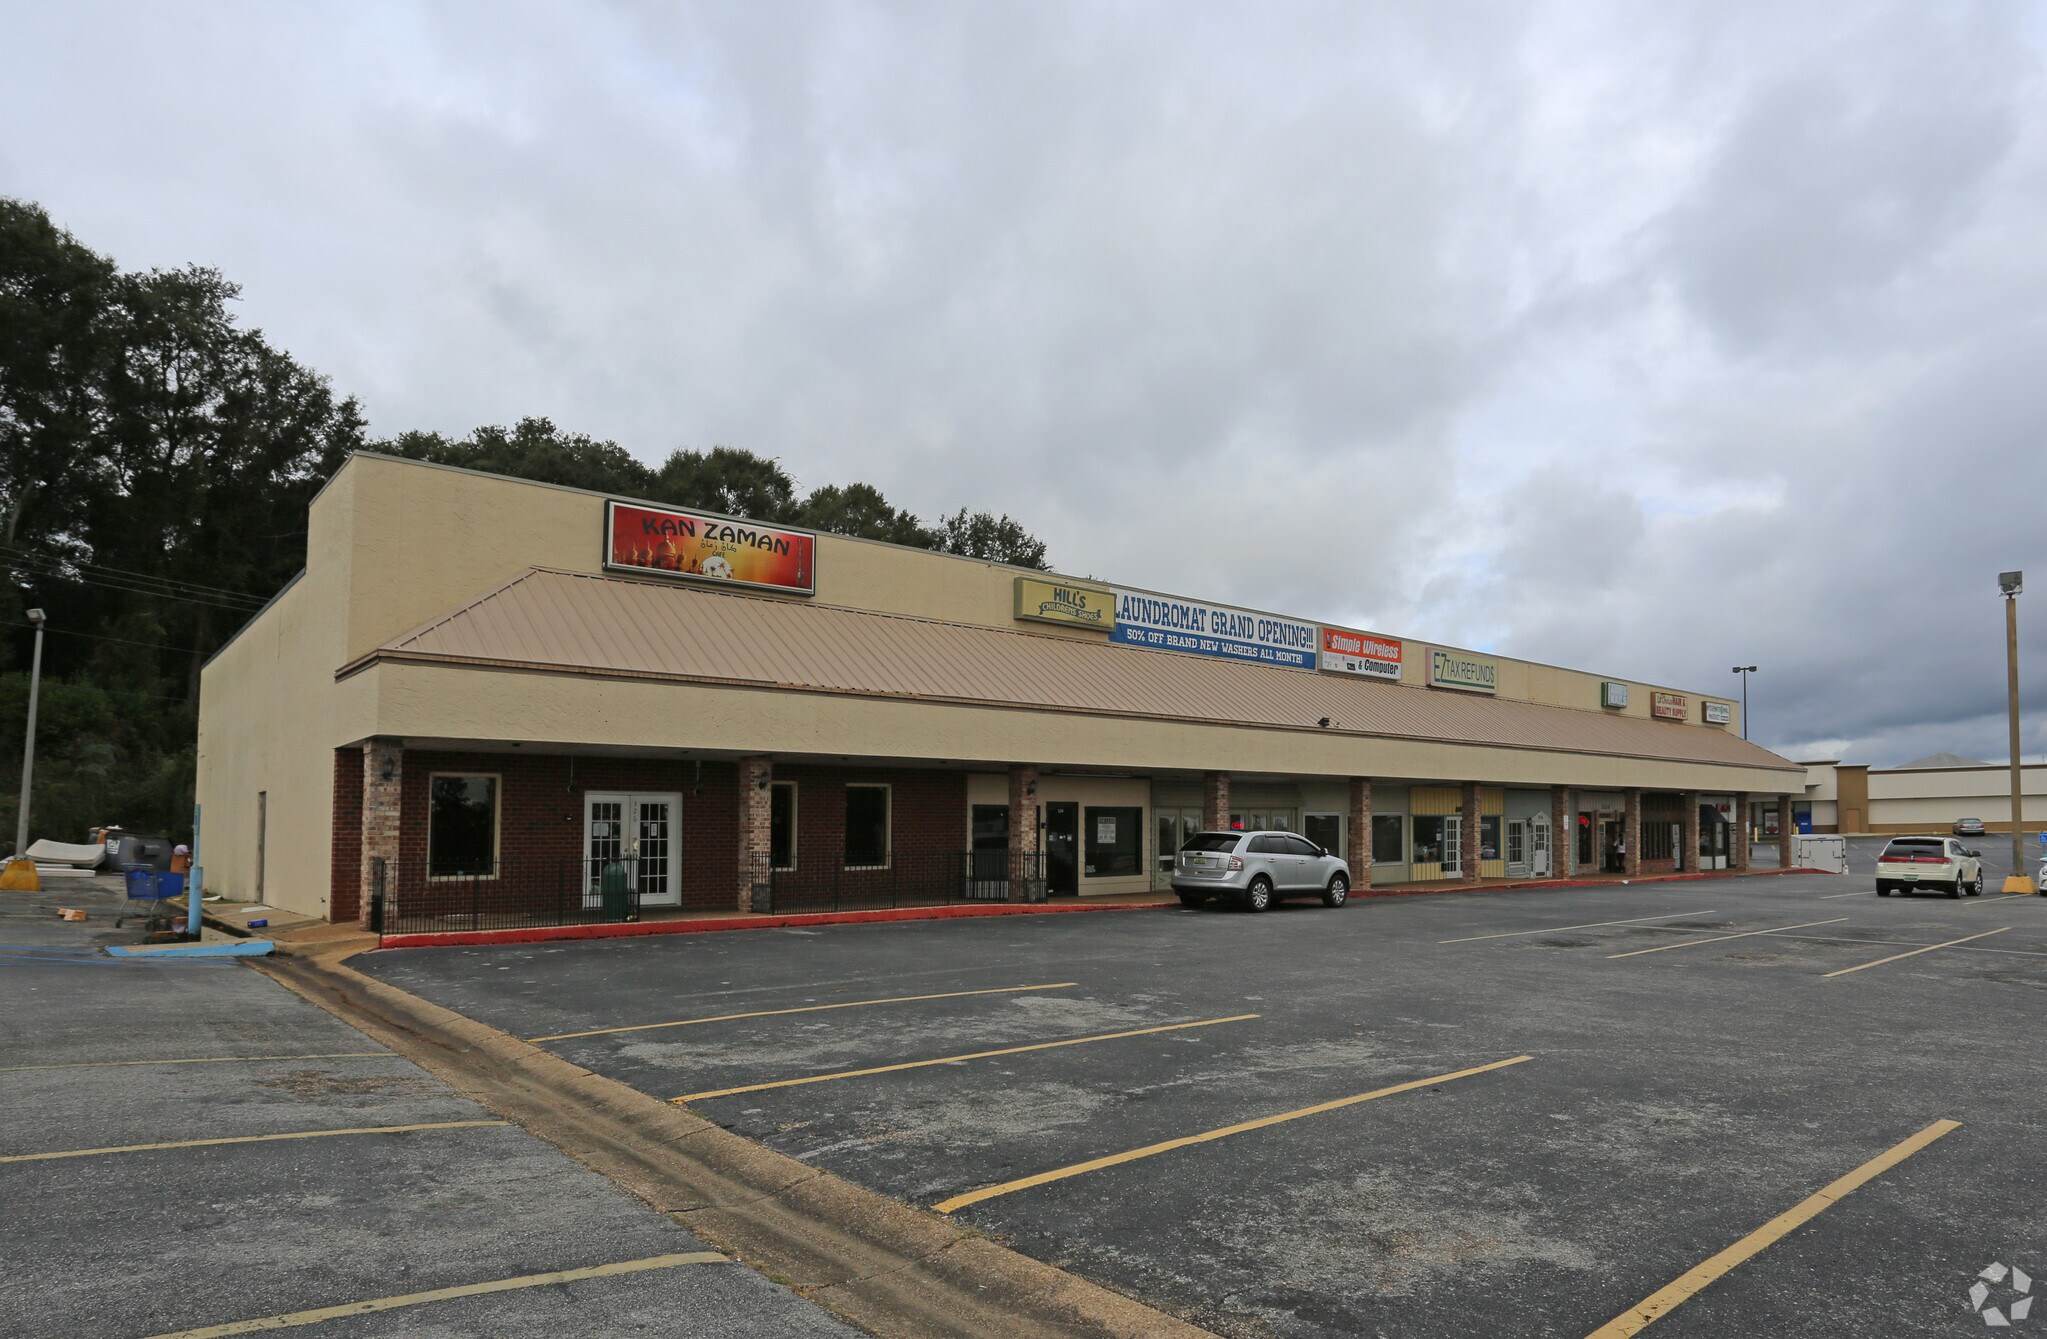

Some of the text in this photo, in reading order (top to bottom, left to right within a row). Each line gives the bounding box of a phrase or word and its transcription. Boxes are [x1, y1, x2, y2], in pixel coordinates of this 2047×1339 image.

[642, 517, 790, 556] KAN ZAMAN
[1053, 587, 1086, 609] HILL'S
[1078, 610, 1098, 620] SHOES
[1211, 611, 1254, 640] GRAND
[1258, 619, 1313, 650] OPENING!!!
[1126, 628, 1303, 664] 50% OFF BRAND NEW WASHERS ALL MONTH!
[1331, 634, 1399, 659] Simple Wireless
[1358, 660, 1363, 670] &
[1364, 659, 1399, 675] Computer
[1461, 661, 1495, 684] REFUNDS
